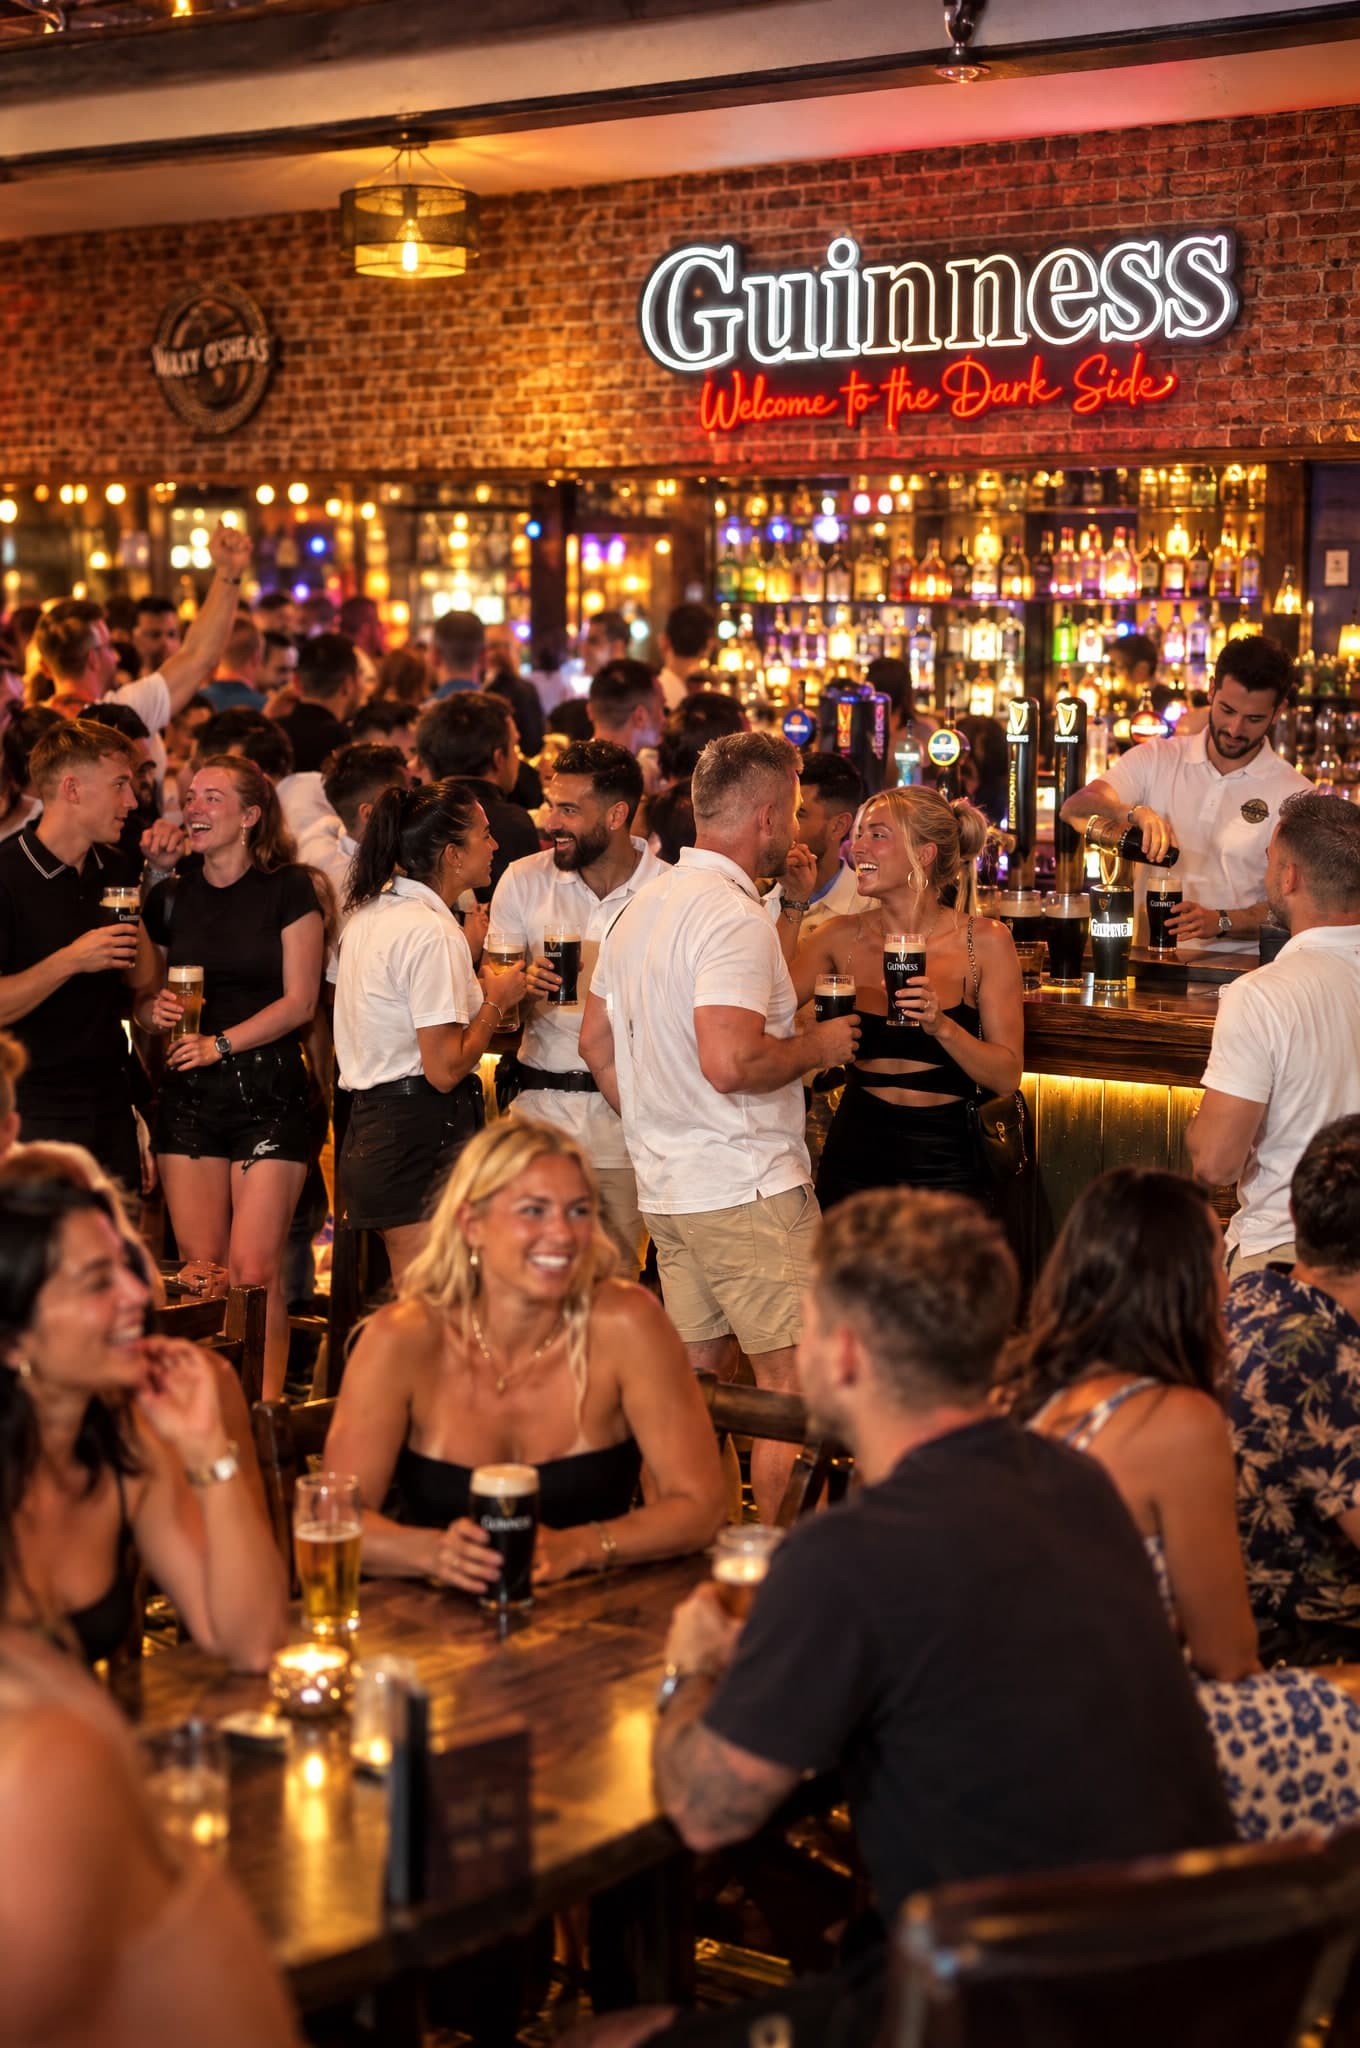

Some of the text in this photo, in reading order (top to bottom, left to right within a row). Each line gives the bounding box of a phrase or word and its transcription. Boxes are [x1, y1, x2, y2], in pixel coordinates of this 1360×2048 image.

[641, 234, 1236, 372] Guinness
[700, 342, 1178, 431] Welcome to the Dark Side
[886, 961, 919, 972] GUINNESS
